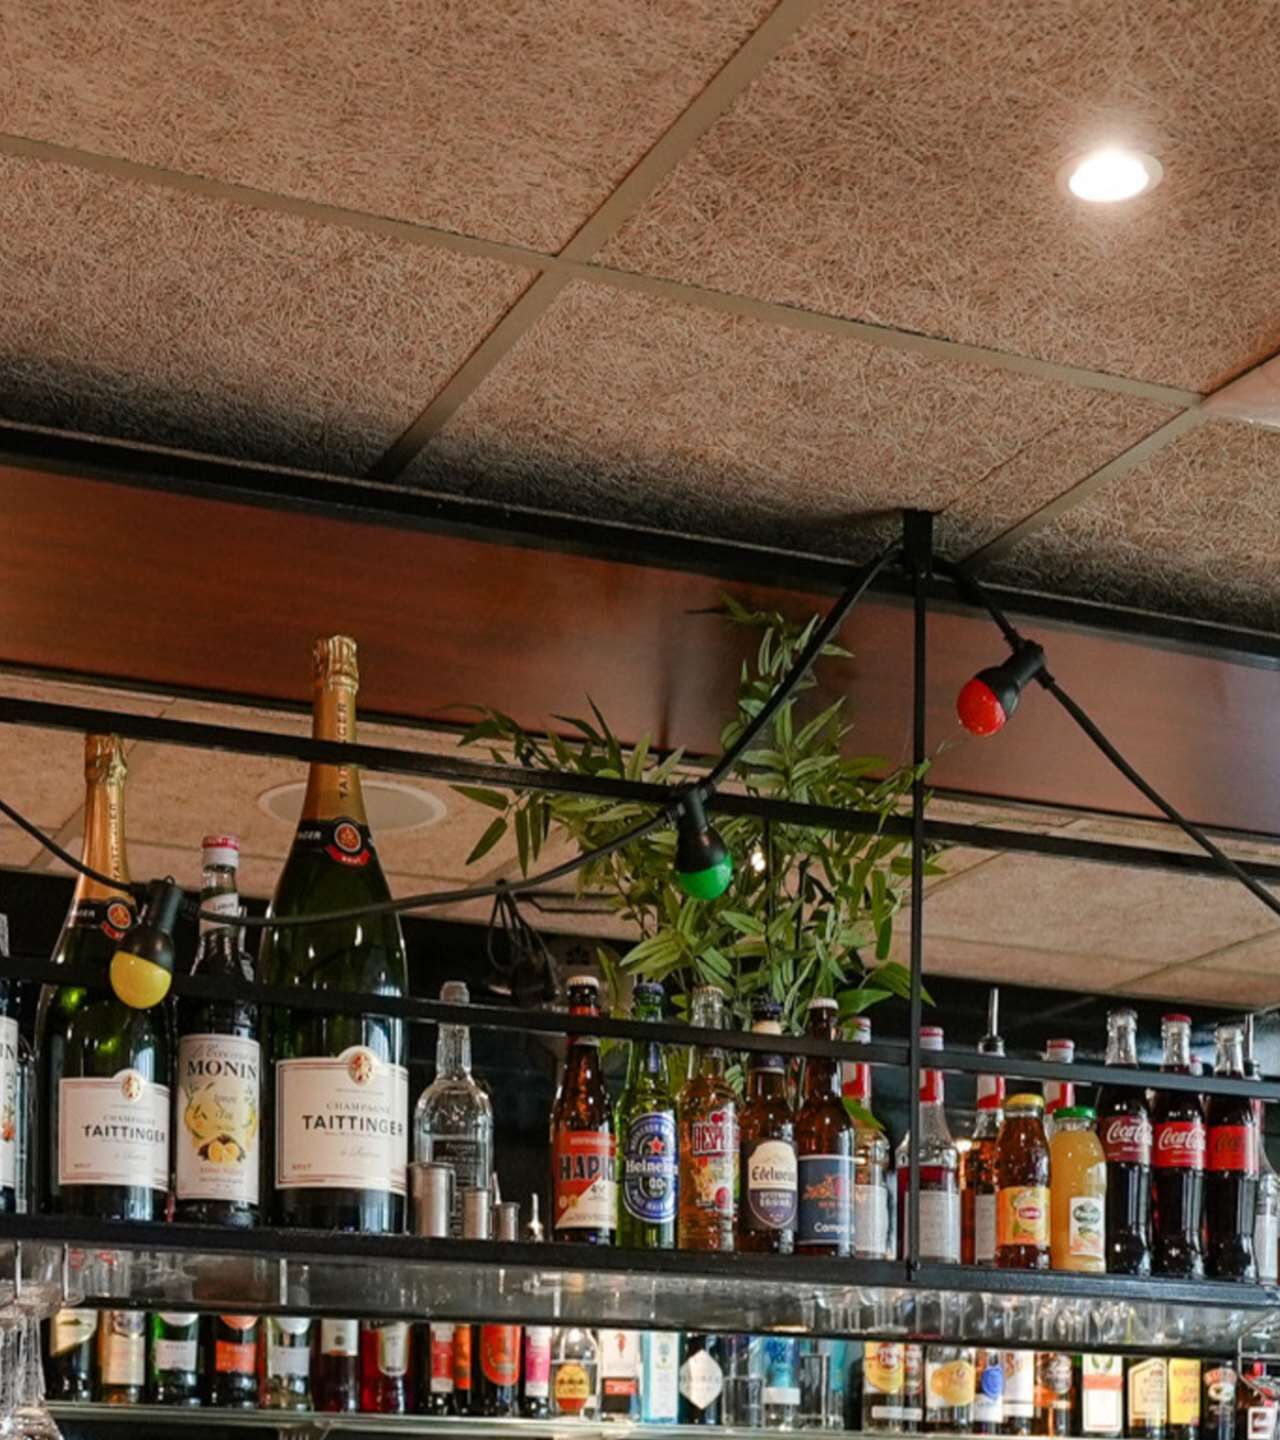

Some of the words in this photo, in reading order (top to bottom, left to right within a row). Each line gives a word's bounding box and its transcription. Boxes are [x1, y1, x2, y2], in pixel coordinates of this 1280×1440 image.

[187, 1060, 257, 1079] MONIN
[83, 1124, 166, 1143] TAITTINGER
[302, 1114, 404, 1136] TAITTINGER
